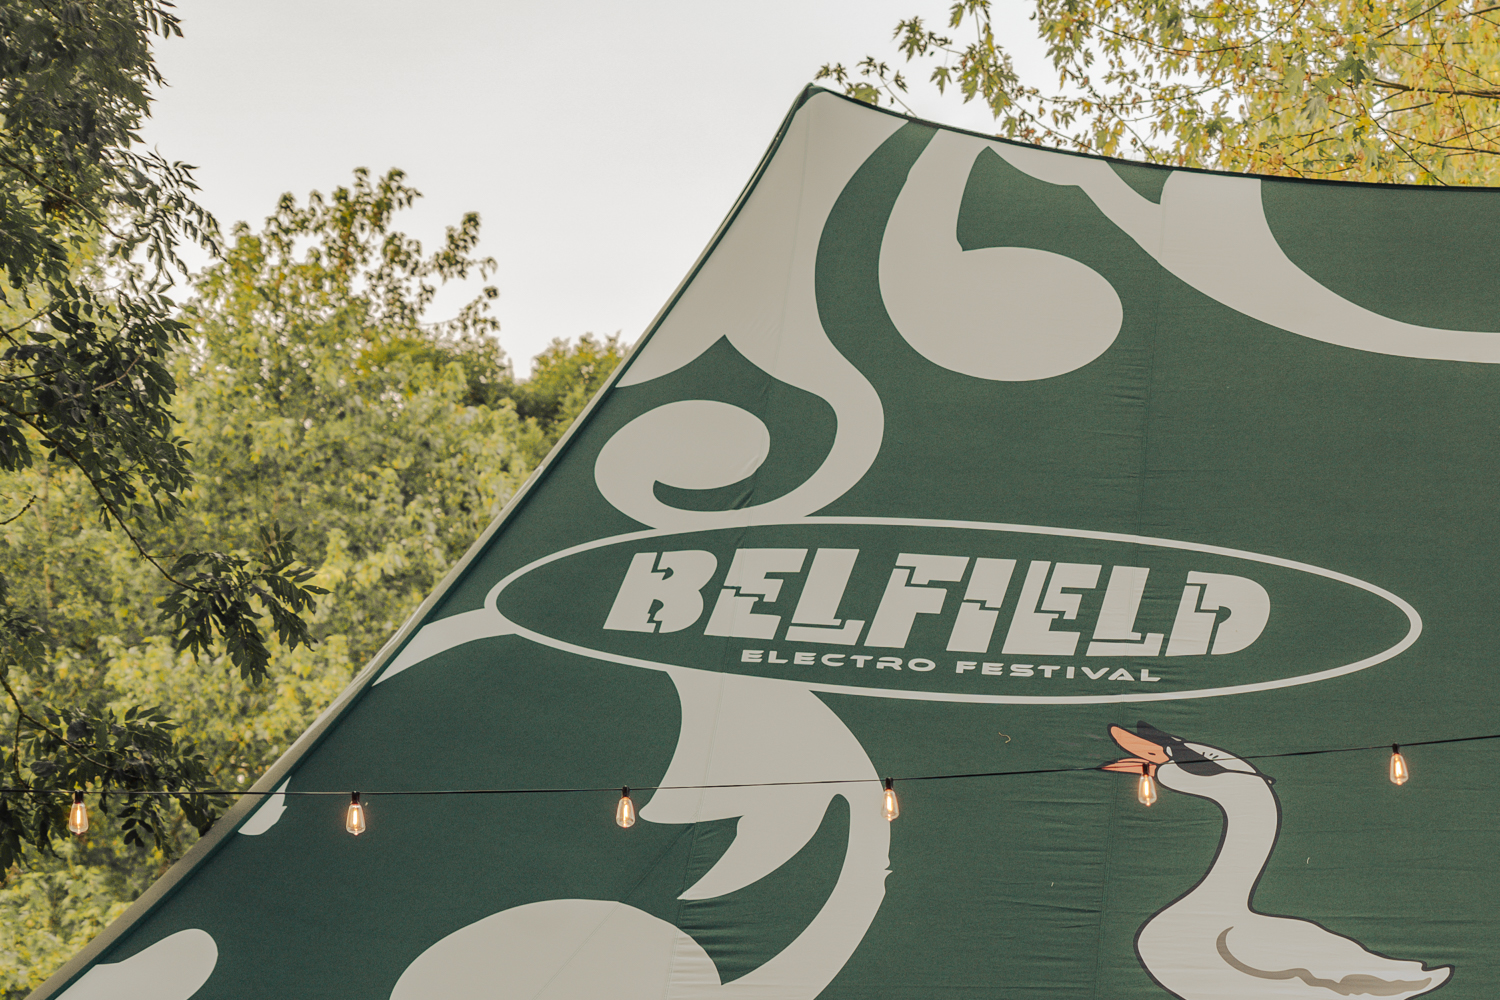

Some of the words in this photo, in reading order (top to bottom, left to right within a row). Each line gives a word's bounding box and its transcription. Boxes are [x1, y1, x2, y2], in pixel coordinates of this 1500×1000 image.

[602, 547, 1271, 661] BELFIELD
[740, 649, 937, 673] ELECTRO
[955, 660, 1162, 683] FESTIVAL
